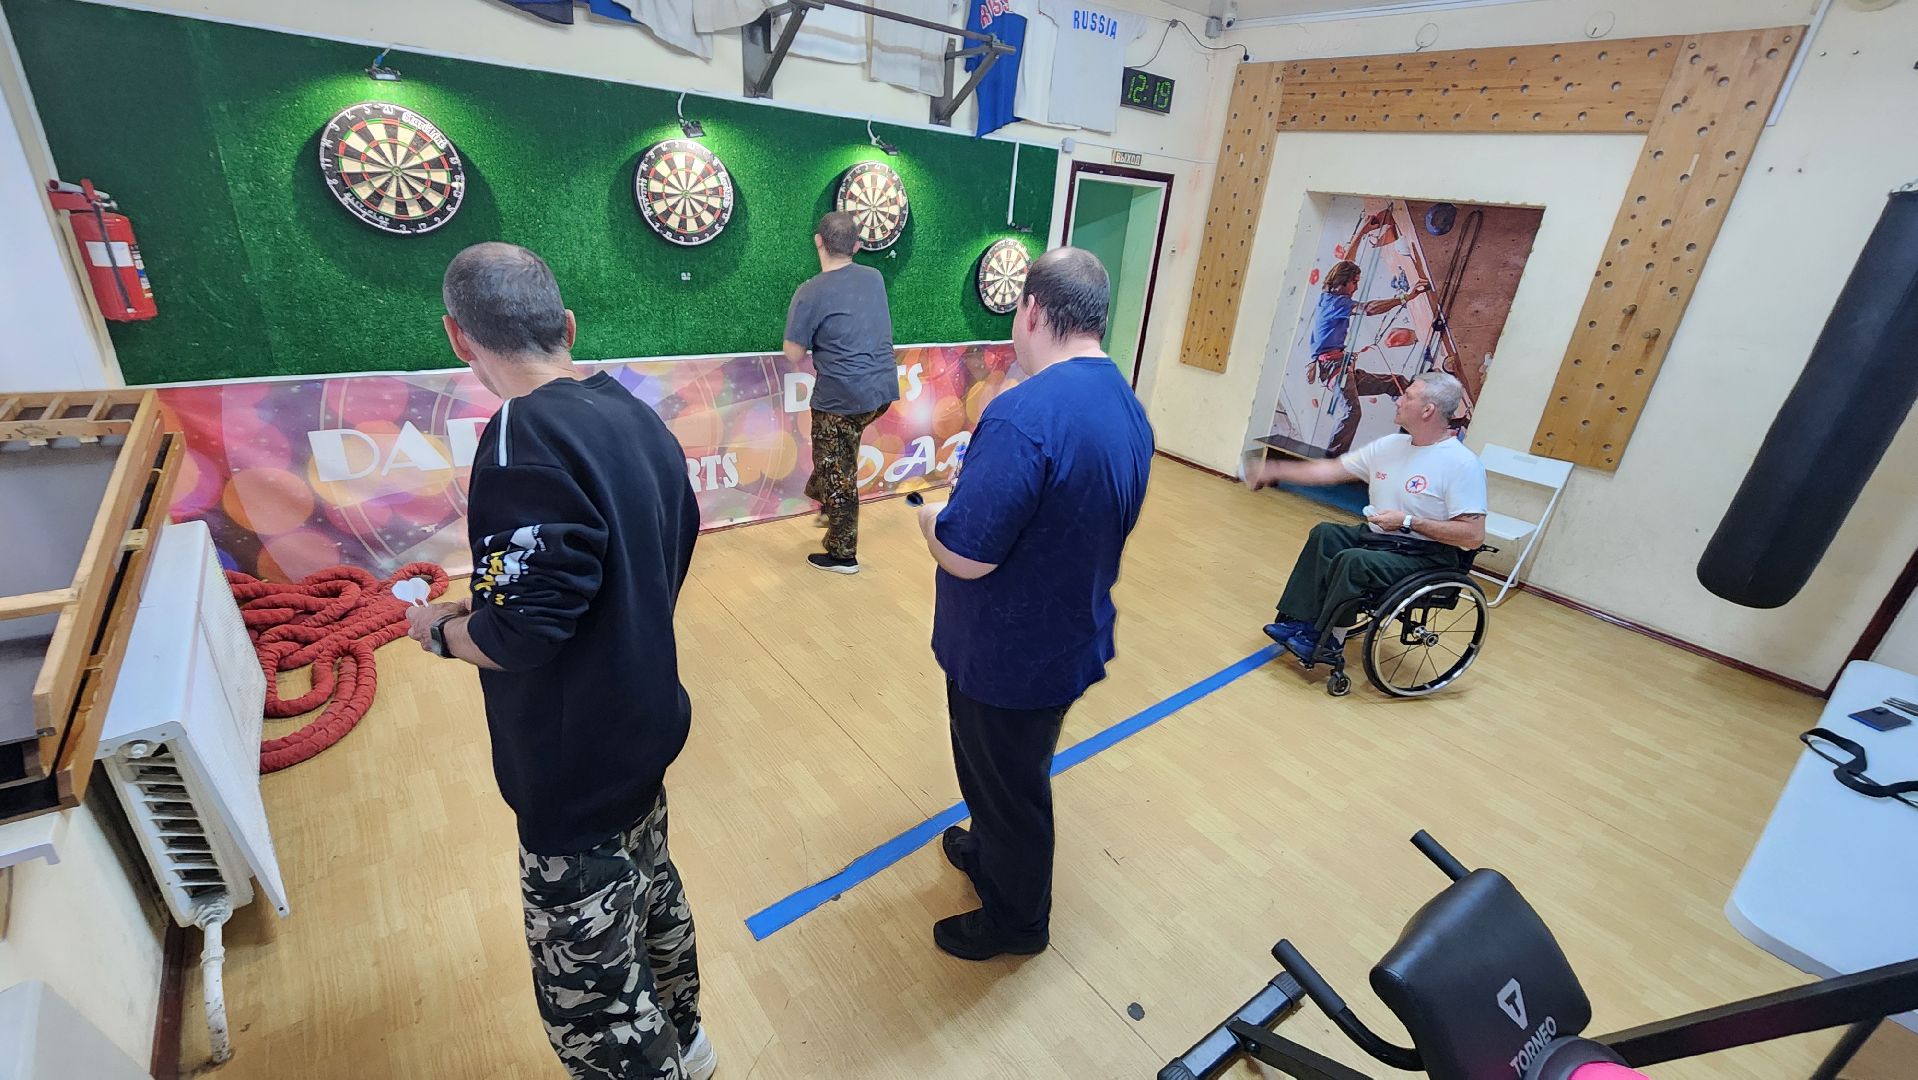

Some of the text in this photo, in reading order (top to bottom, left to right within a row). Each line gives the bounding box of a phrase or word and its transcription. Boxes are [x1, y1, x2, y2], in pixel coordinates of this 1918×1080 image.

[1073, 10, 1118, 39] RUSSIA
[1128, 74, 1171, 109] 12:19
[1115, 152, 1141, 165] ВЫХОД
[1509, 1016, 1557, 1078] TORNEO
